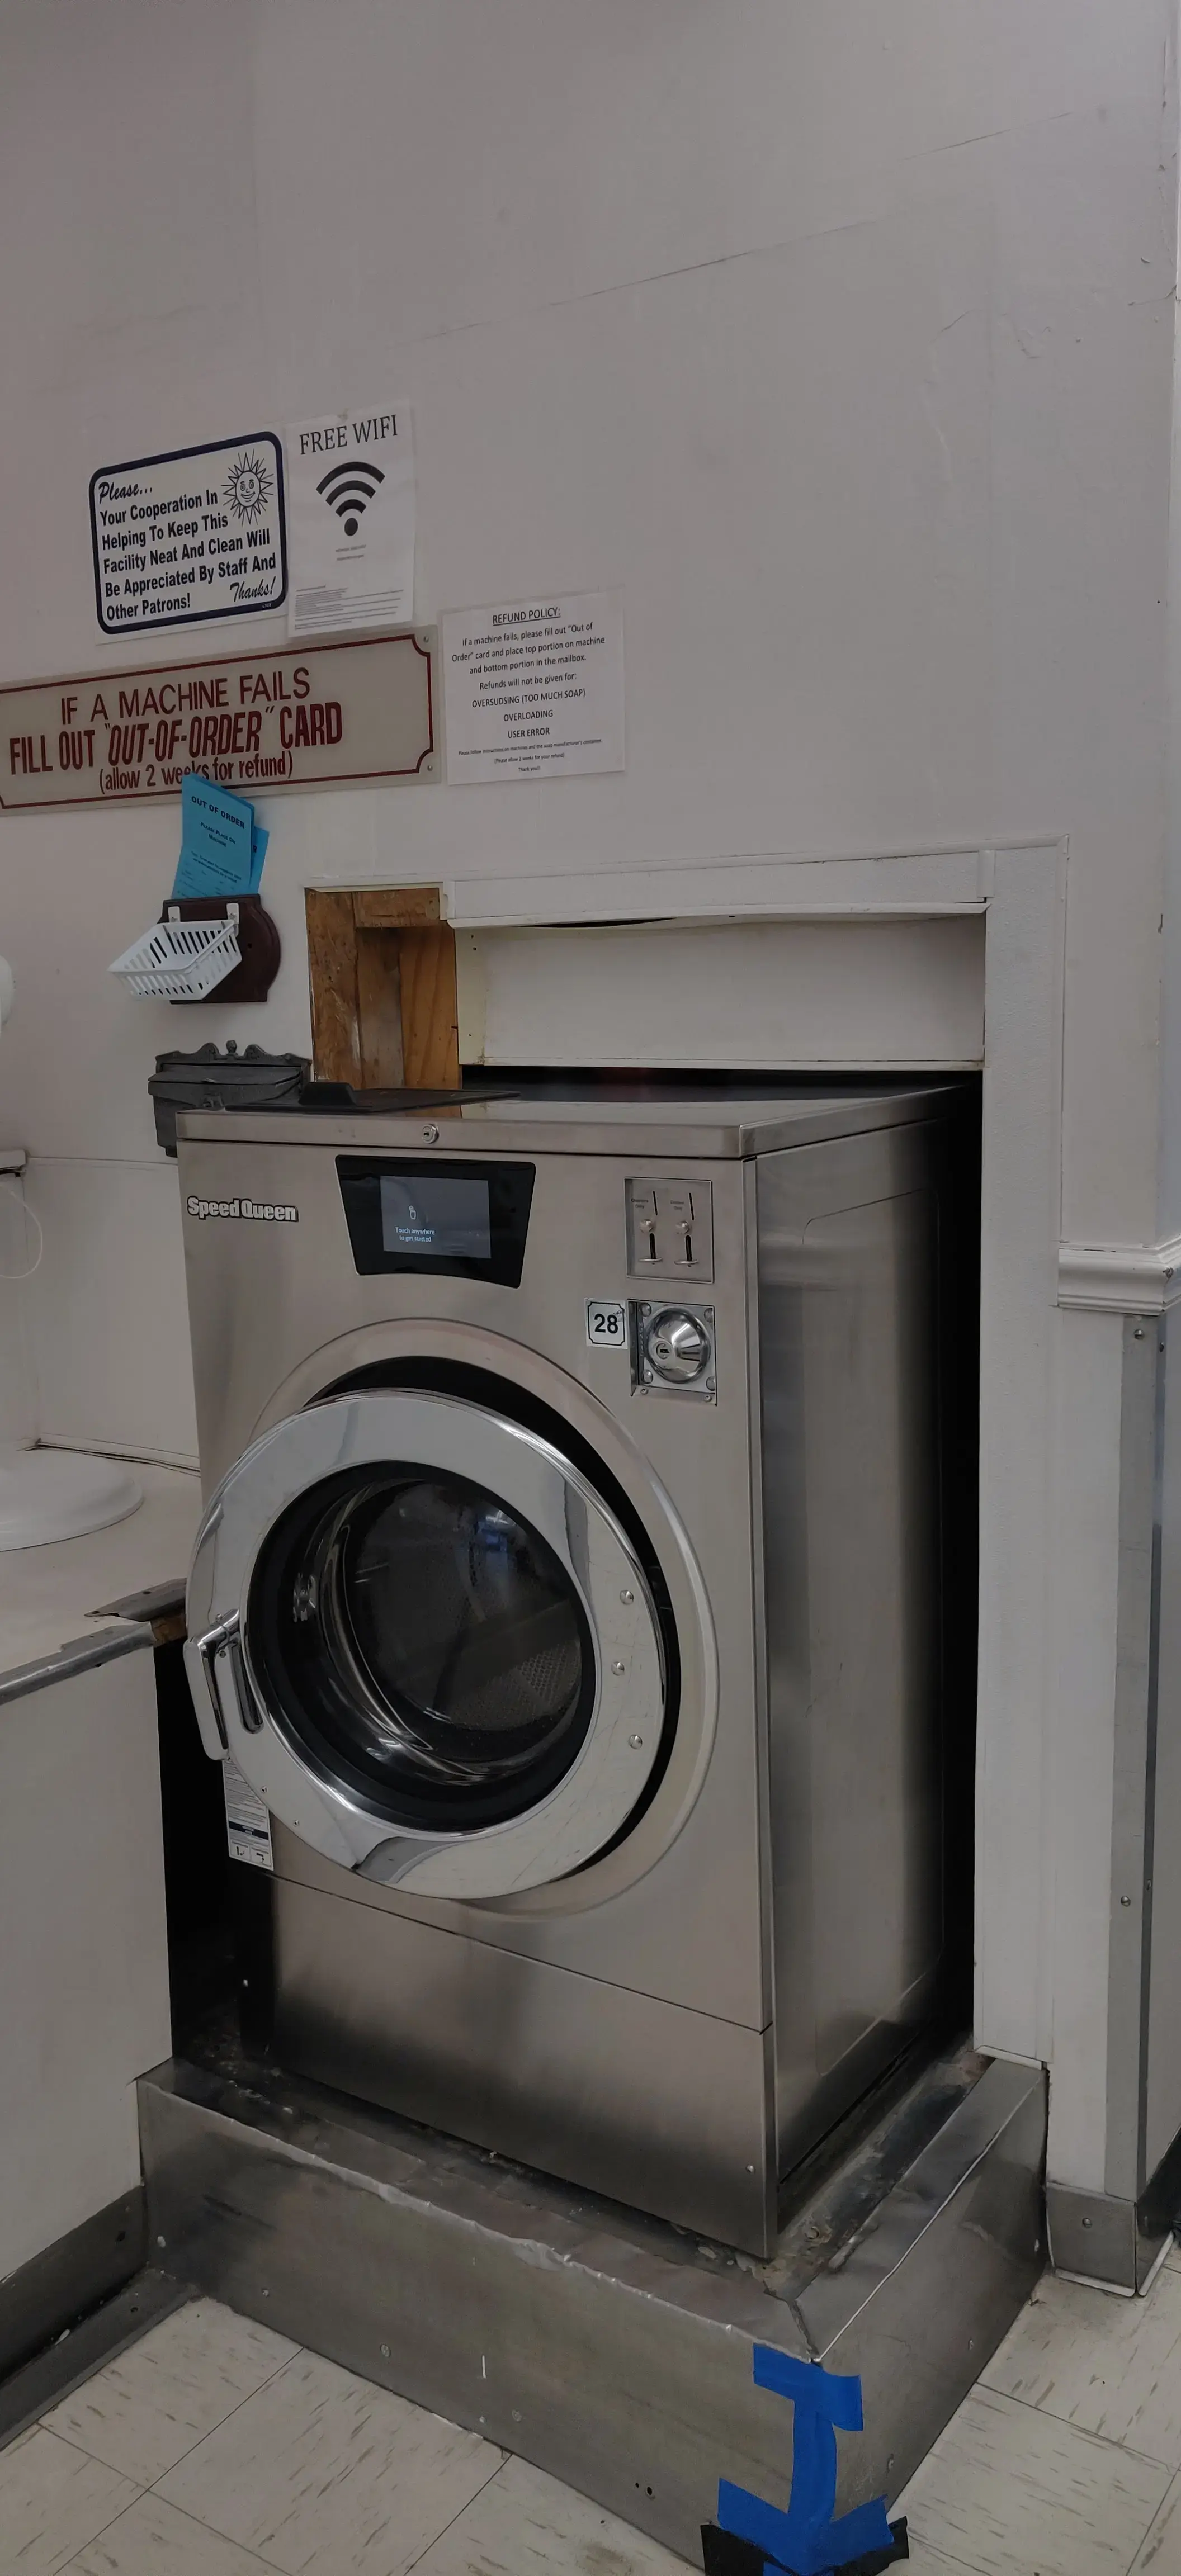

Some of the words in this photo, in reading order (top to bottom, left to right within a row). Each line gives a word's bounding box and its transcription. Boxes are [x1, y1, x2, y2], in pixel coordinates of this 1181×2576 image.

[299, 425, 348, 455] FREE
[352, 414, 398, 444] WIFI
[98, 481, 153, 504] Please...
[100, 509, 126, 527] Your
[130, 494, 202, 522] Cooperation
[206, 489, 218, 506] In
[102, 529, 146, 551] Helping
[149, 525, 164, 542] To
[168, 520, 198, 538] Keep
[201, 513, 228, 532] This
[103, 553, 146, 574] Facility
[150, 549, 178, 566] Neat
[182, 541, 204, 560] And
[208, 534, 243, 555] Clean
[247, 528, 270, 548] Will
[105, 581, 120, 598] Be
[124, 567, 195, 597] Appreciated
[199, 565, 214, 584] By
[218, 557, 248, 578] Staff
[252, 552, 276, 572] And
[229, 576, 276, 602] Thanks!
[107, 603, 139, 621] Other
[142, 593, 191, 615] Patrons!
[493, 610, 526, 624] REFUND
[528, 607, 561, 619] POLICY:
[462, 638, 467, 646] If
[474, 634, 502, 645] machine
[503, 632, 519, 642] fails,
[521, 630, 543, 641] please
[544, 624, 554, 636] fill
[554, 627, 566, 635] out
[585, 622, 593, 631] of
[475, 649, 490, 659] card
[492, 648, 504, 657] and
[506, 646, 524, 657] place
[525, 645, 537, 655] top
[538, 642, 564, 653] portion
[575, 636, 606, 647] machine
[469, 665, 482, 674] and
[483, 662, 508, 673] bottom
[509, 660, 535, 671] portion
[544, 656, 556, 665] the
[557, 654, 587, 664] mailbox.
[480, 679, 507, 690] Refunds
[508, 676, 519, 687] will
[521, 676, 533, 686] not
[534, 675, 543, 684] be
[544, 674, 563, 684] given
[564, 672, 577, 681] for:
[61, 697, 78, 725] IF
[91, 693, 108, 723] A
[119, 678, 229, 719] MACHINE
[240, 667, 310, 704] FAILS
[471, 695, 520, 708] OVERSUDSING
[521, 693, 539, 704] (TOO
[540, 691, 563, 702] MUCH
[564, 688, 586, 698] SOAP)
[503, 709, 554, 722] OVERLOADING
[8, 735, 53, 775] FILL
[59, 729, 96, 770] OUT
[280, 702, 343, 749] CARD
[507, 729, 526, 738] USER
[527, 727, 550, 737] ERROR
[99, 767, 140, 795] (allow
[147, 765, 156, 787] 2
[212, 756, 234, 780] for
[239, 751, 292, 779] refund)
[191, 796, 207, 808] OUT
[209, 804, 219, 814] OF
[220, 811, 244, 829] ORDER
[188, 1196, 240, 1220] Speed
[240, 1198, 299, 1222] Queen
[594, 1314, 618, 1334] 28
